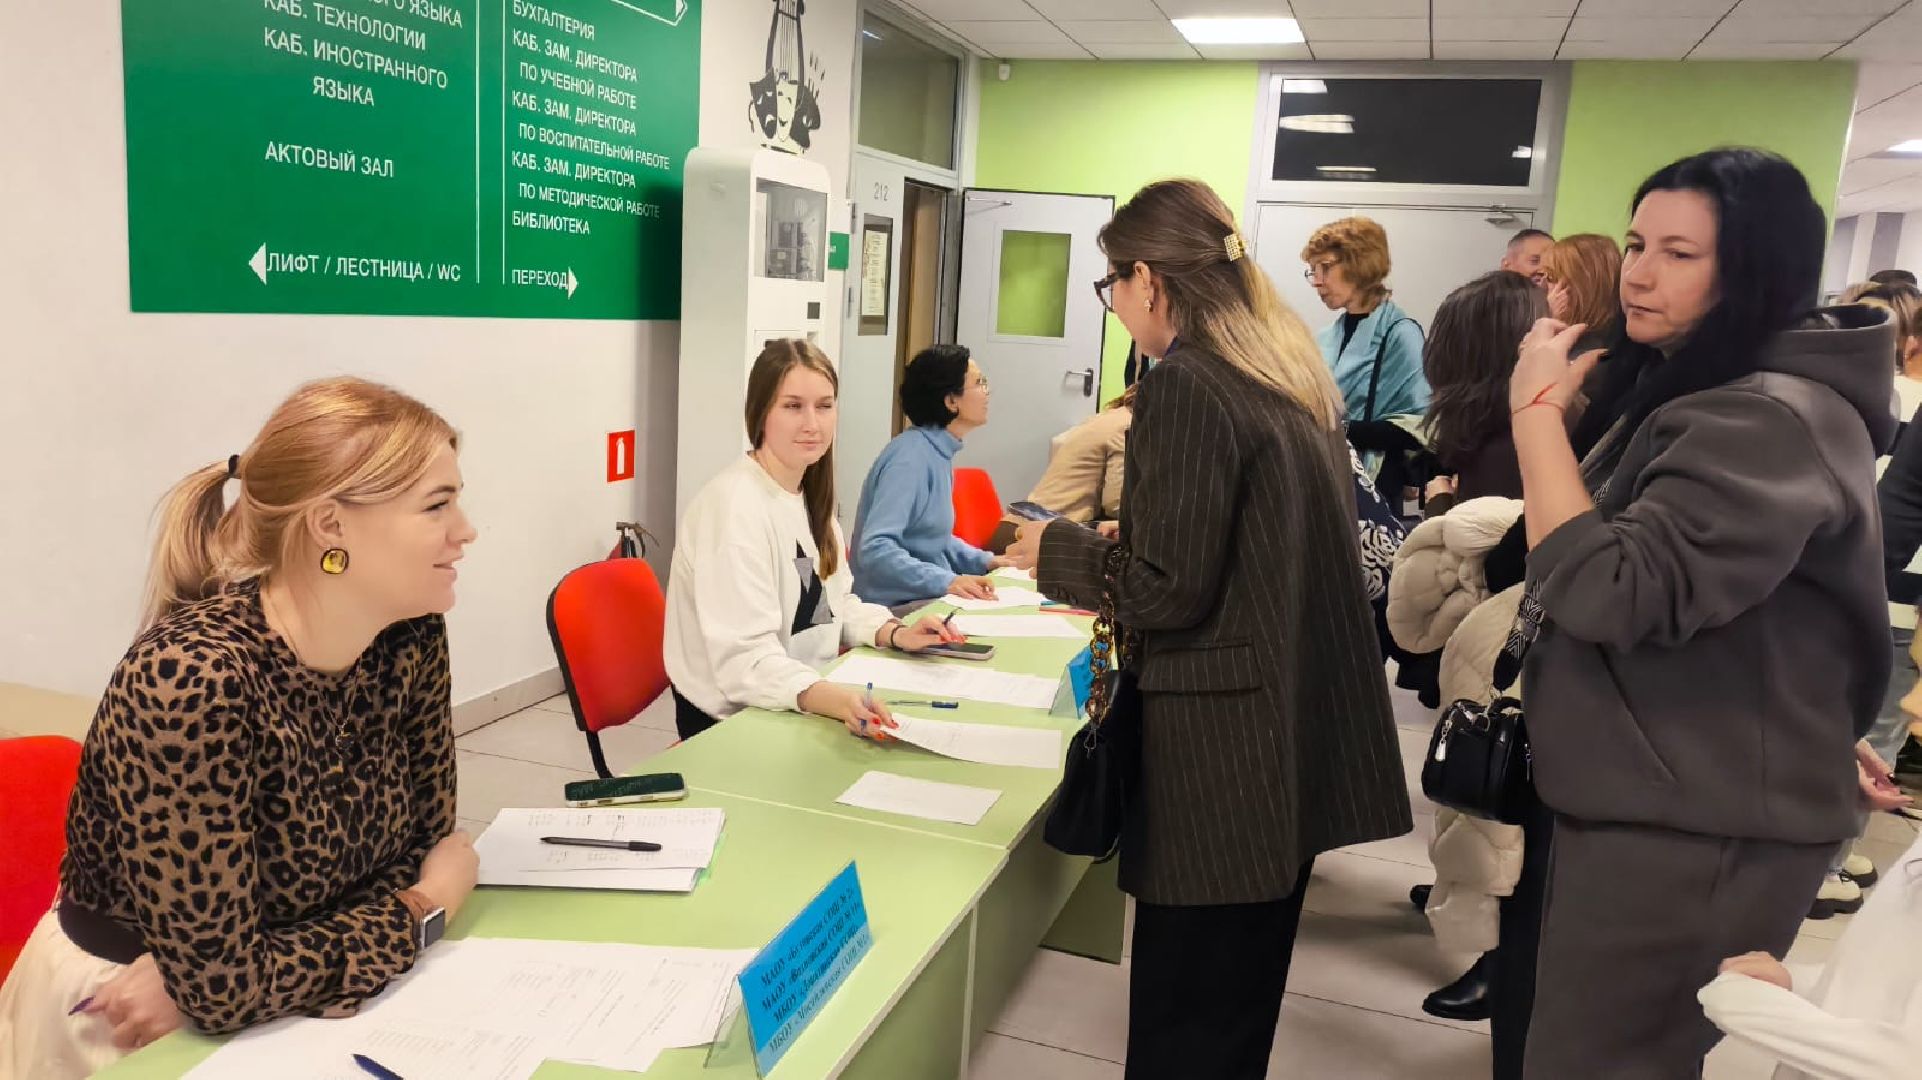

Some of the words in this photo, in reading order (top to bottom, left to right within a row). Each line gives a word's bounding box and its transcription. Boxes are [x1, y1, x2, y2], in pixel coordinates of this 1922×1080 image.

[314, 3, 425, 50] ТЕХНОЛОГИИ
[410, 0, 462, 28] ЯЗЫКА
[514, 0, 594, 40] БУХГАЛТЕРИЯ
[265, 27, 307, 56] КАБ.
[314, 39, 448, 90] ИНОСТРАННОГО
[512, 28, 541, 52] КАБ.
[545, 39, 572, 62] ЗАМ.
[576, 50, 637, 82] ДИРЕКТОРА
[313, 76, 374, 106] ЯЗЫКА
[520, 62, 538, 81] ПО
[541, 68, 594, 97] УЧЕБНОЙ
[598, 85, 636, 109] РАБОТЕ
[512, 90, 540, 112] КАБ.
[544, 99, 571, 120] ЗАМ.
[575, 107, 636, 136] ДИРЕКТОРА
[265, 141, 355, 172] АКТОВЫЙ
[361, 156, 394, 177] ЗАЛ
[518, 122, 536, 140] ПО
[539, 128, 635, 162] ВОСПИТАТЕЛЬНОЙ
[636, 150, 669, 169] РАБОТЕ
[512, 151, 540, 170] КАБ.
[544, 157, 571, 176] ЗАМ.
[575, 163, 636, 188] ДИРЕКТОРА
[519, 182, 535, 199] ПО
[539, 186, 623, 211] МЕТОДИЧЕСКОЙ
[627, 200, 659, 217] РАБОТЕ
[874, 182, 889, 201] 212
[512, 211, 591, 235] БИБЛИОТЕКА
[267, 253, 319, 273] ЛИФТ
[336, 257, 424, 282] ЛЕСТНИЦА
[437, 264, 460, 281] WC
[512, 269, 567, 290] ПЕРЕХОД
